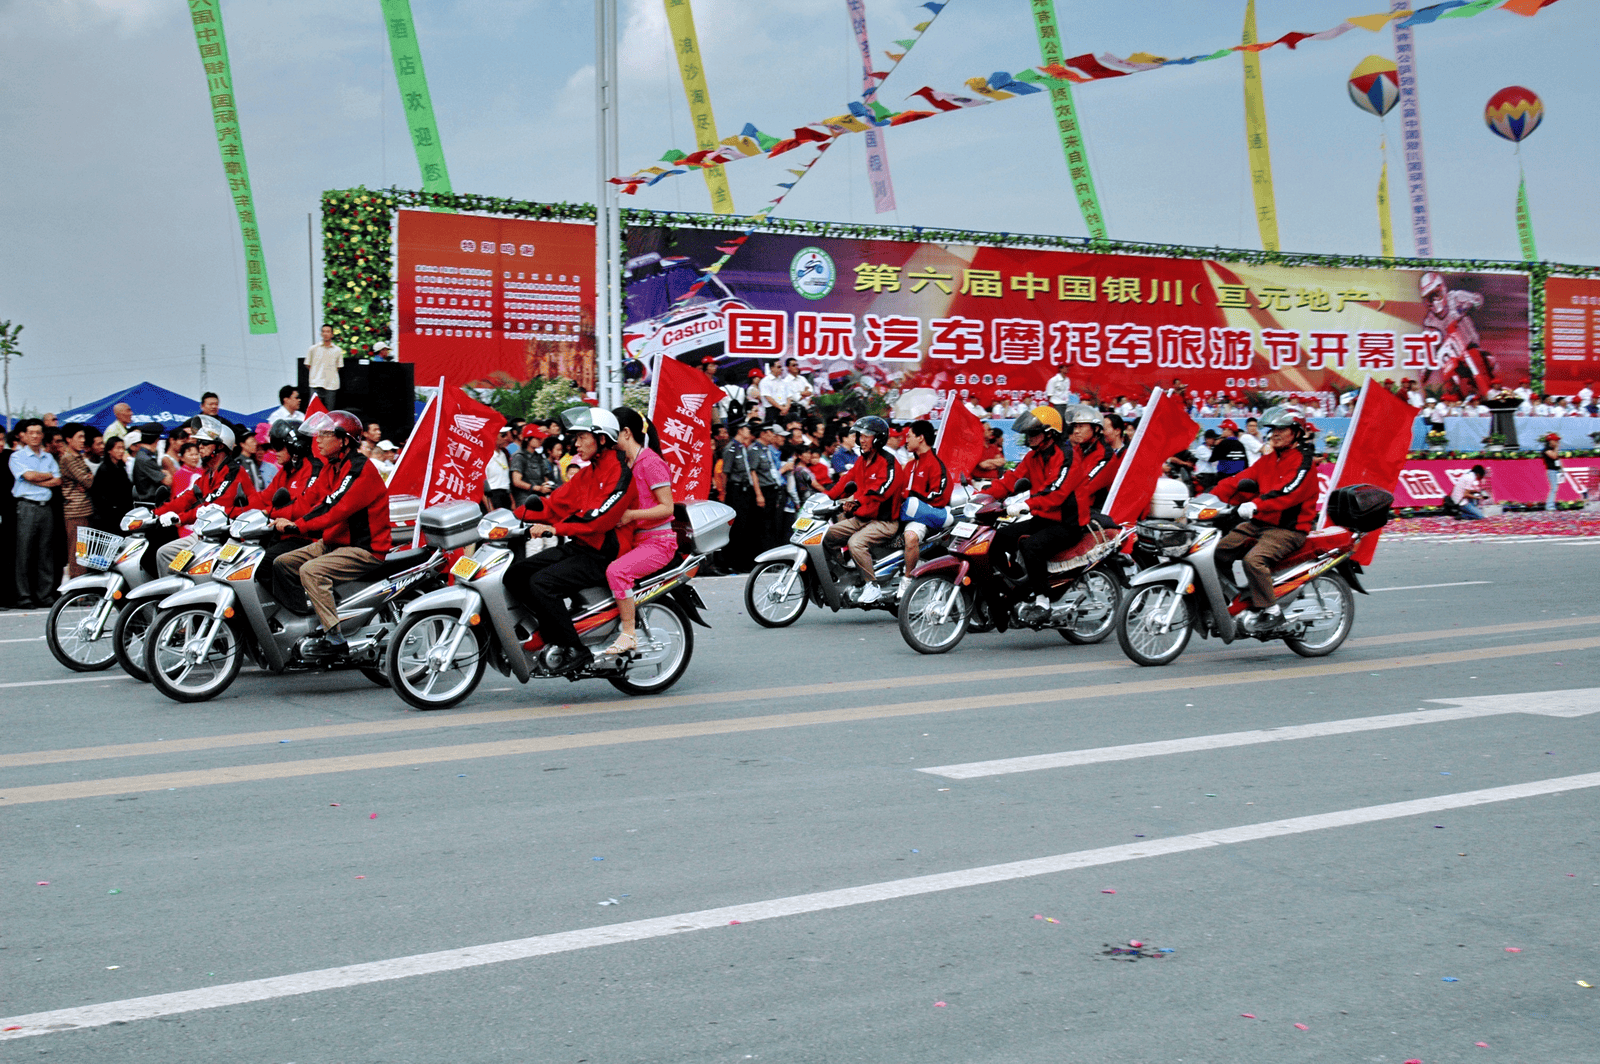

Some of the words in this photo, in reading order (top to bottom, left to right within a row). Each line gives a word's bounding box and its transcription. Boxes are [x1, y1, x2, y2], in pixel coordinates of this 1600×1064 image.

[662, 317, 723, 347] Castrol
[723, 308, 1443, 370] 国际汽车摩托车旅游节开幕式
[449, 424, 484, 448] HONDA
